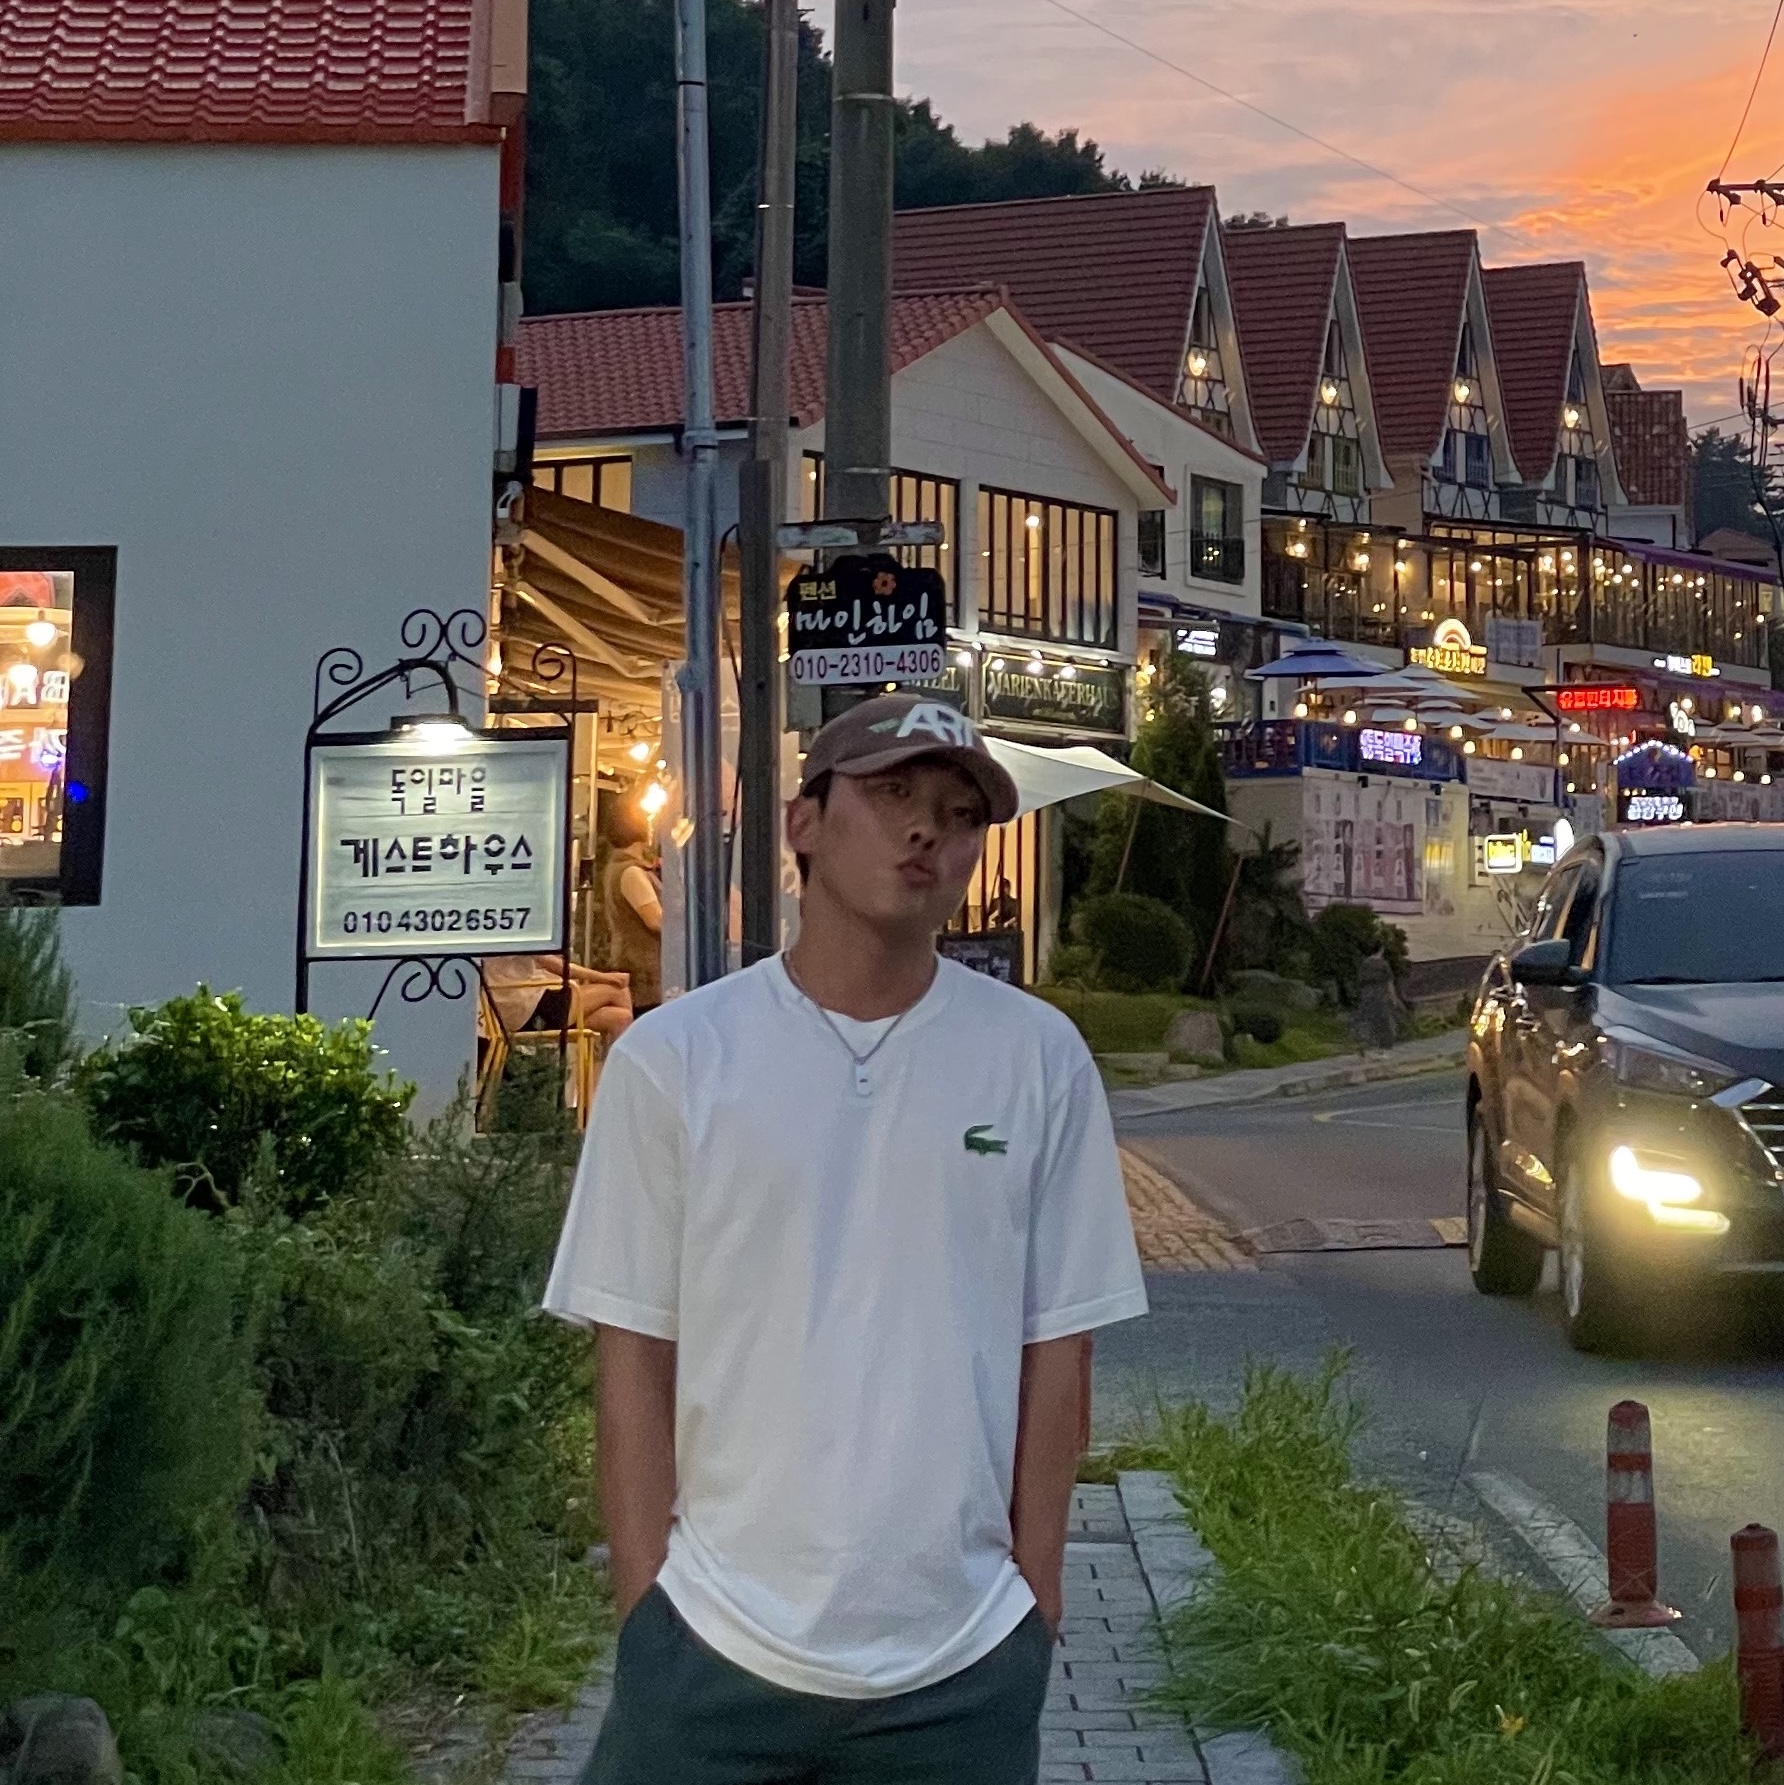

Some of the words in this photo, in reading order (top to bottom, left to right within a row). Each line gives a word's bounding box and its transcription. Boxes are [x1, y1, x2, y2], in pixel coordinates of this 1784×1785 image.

[799, 580, 837, 601] 펜션
[794, 649, 941, 680] 010-2310-4306
[391, 766, 486, 815] 독일마을
[340, 833, 533, 878] 게스트하우스
[343, 907, 531, 934] 01043026557
